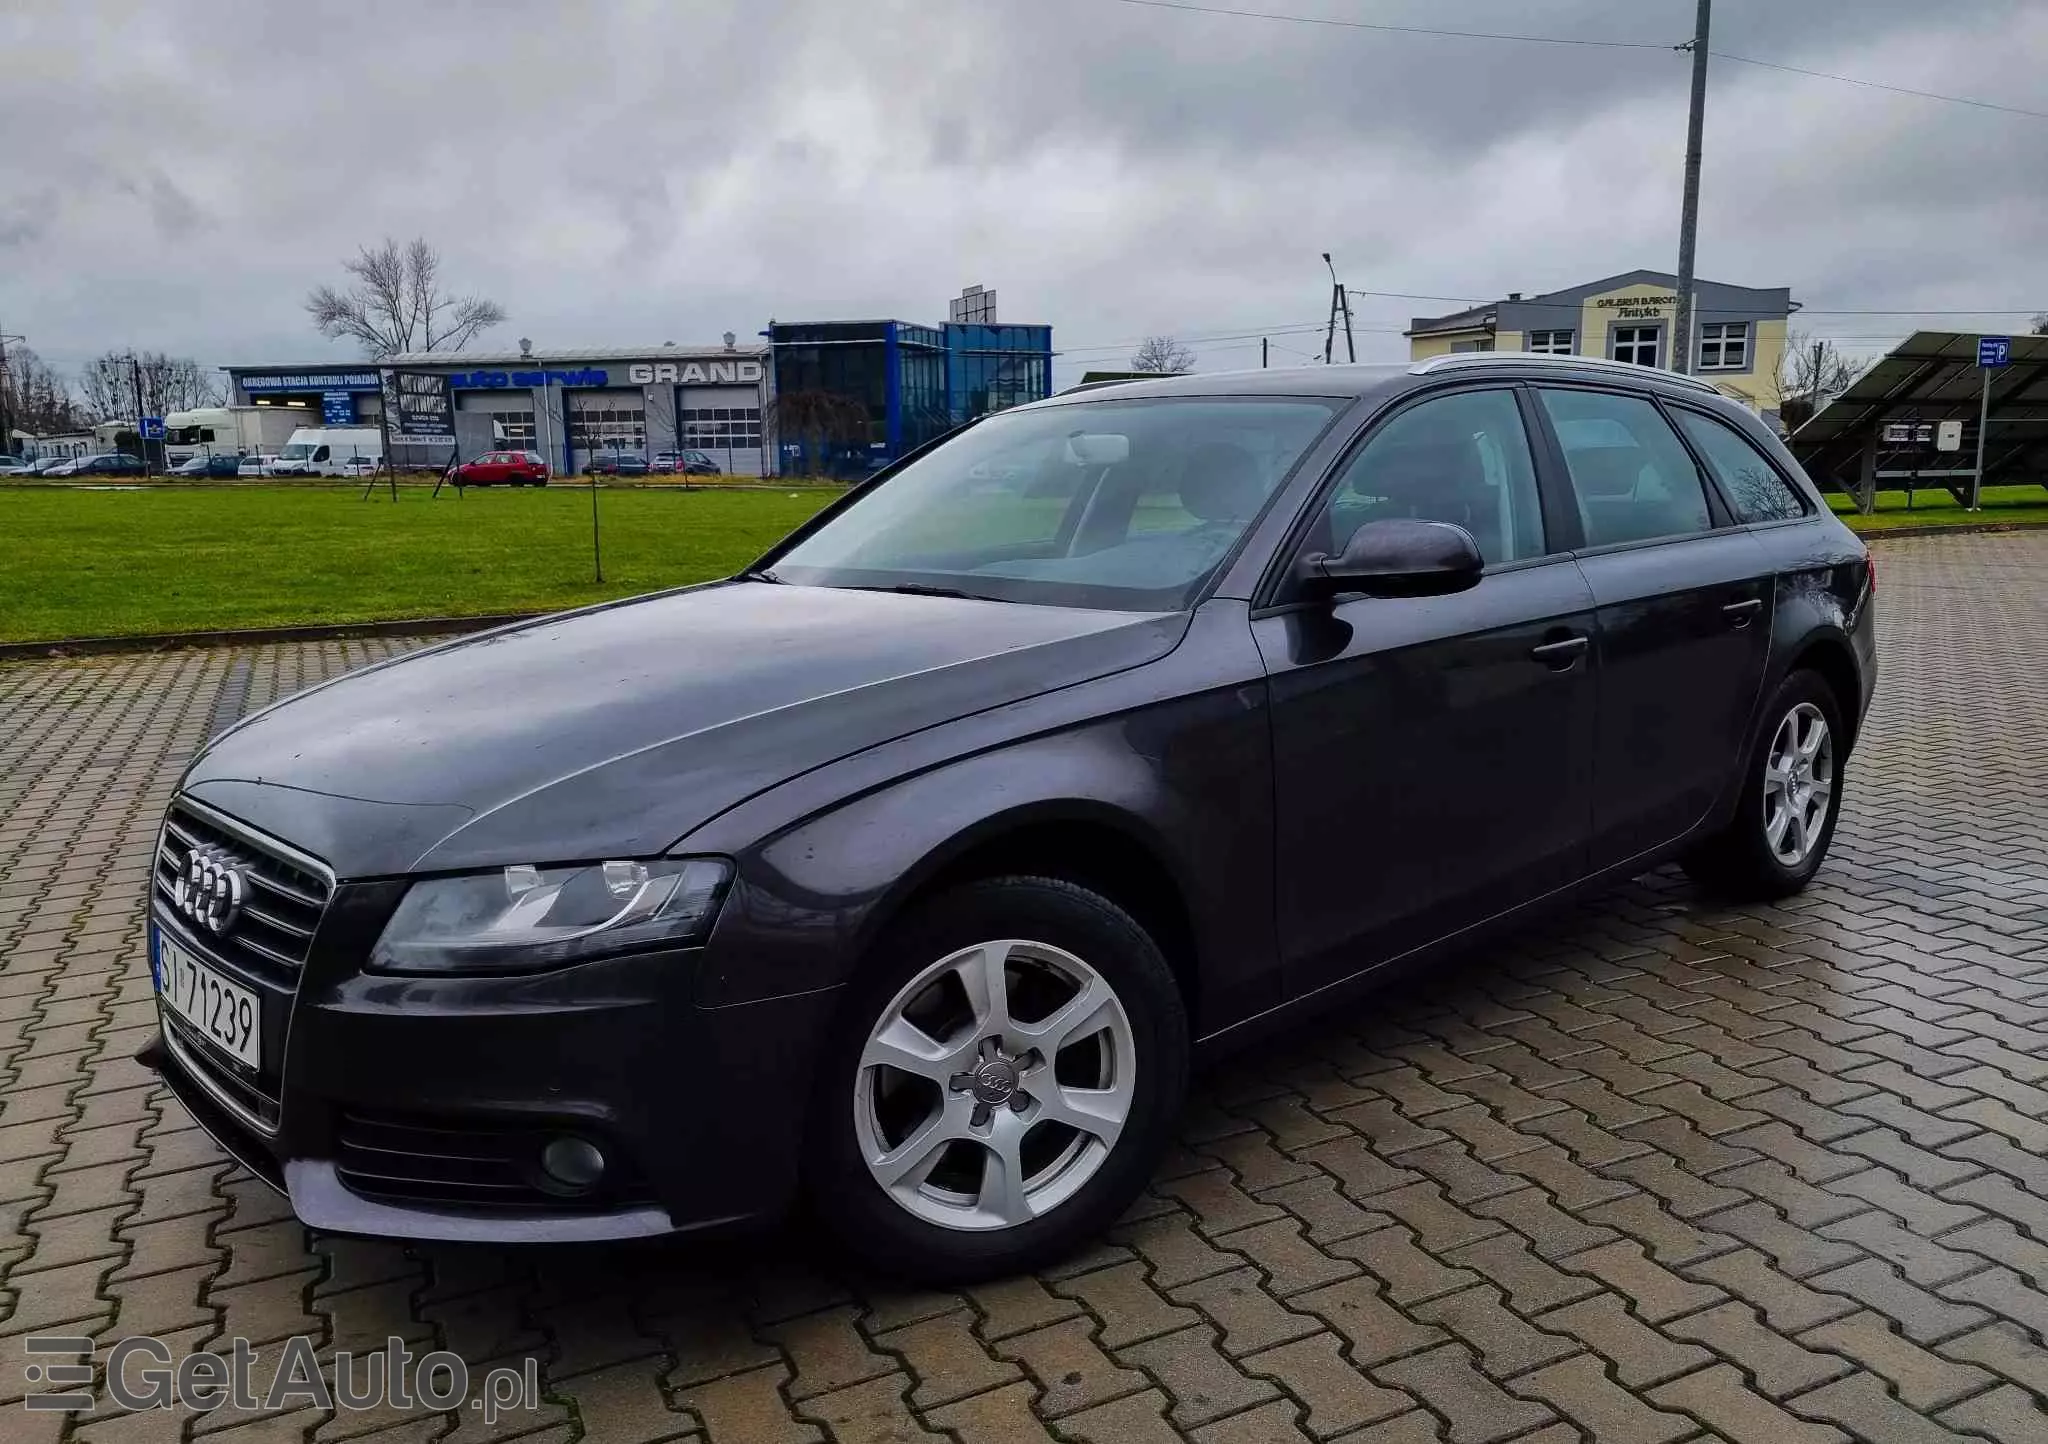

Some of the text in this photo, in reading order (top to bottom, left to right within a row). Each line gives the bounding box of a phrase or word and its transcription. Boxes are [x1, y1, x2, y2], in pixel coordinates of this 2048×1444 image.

[630, 362, 762, 384] GRAND
[161, 940, 252, 1053] SI 71239
